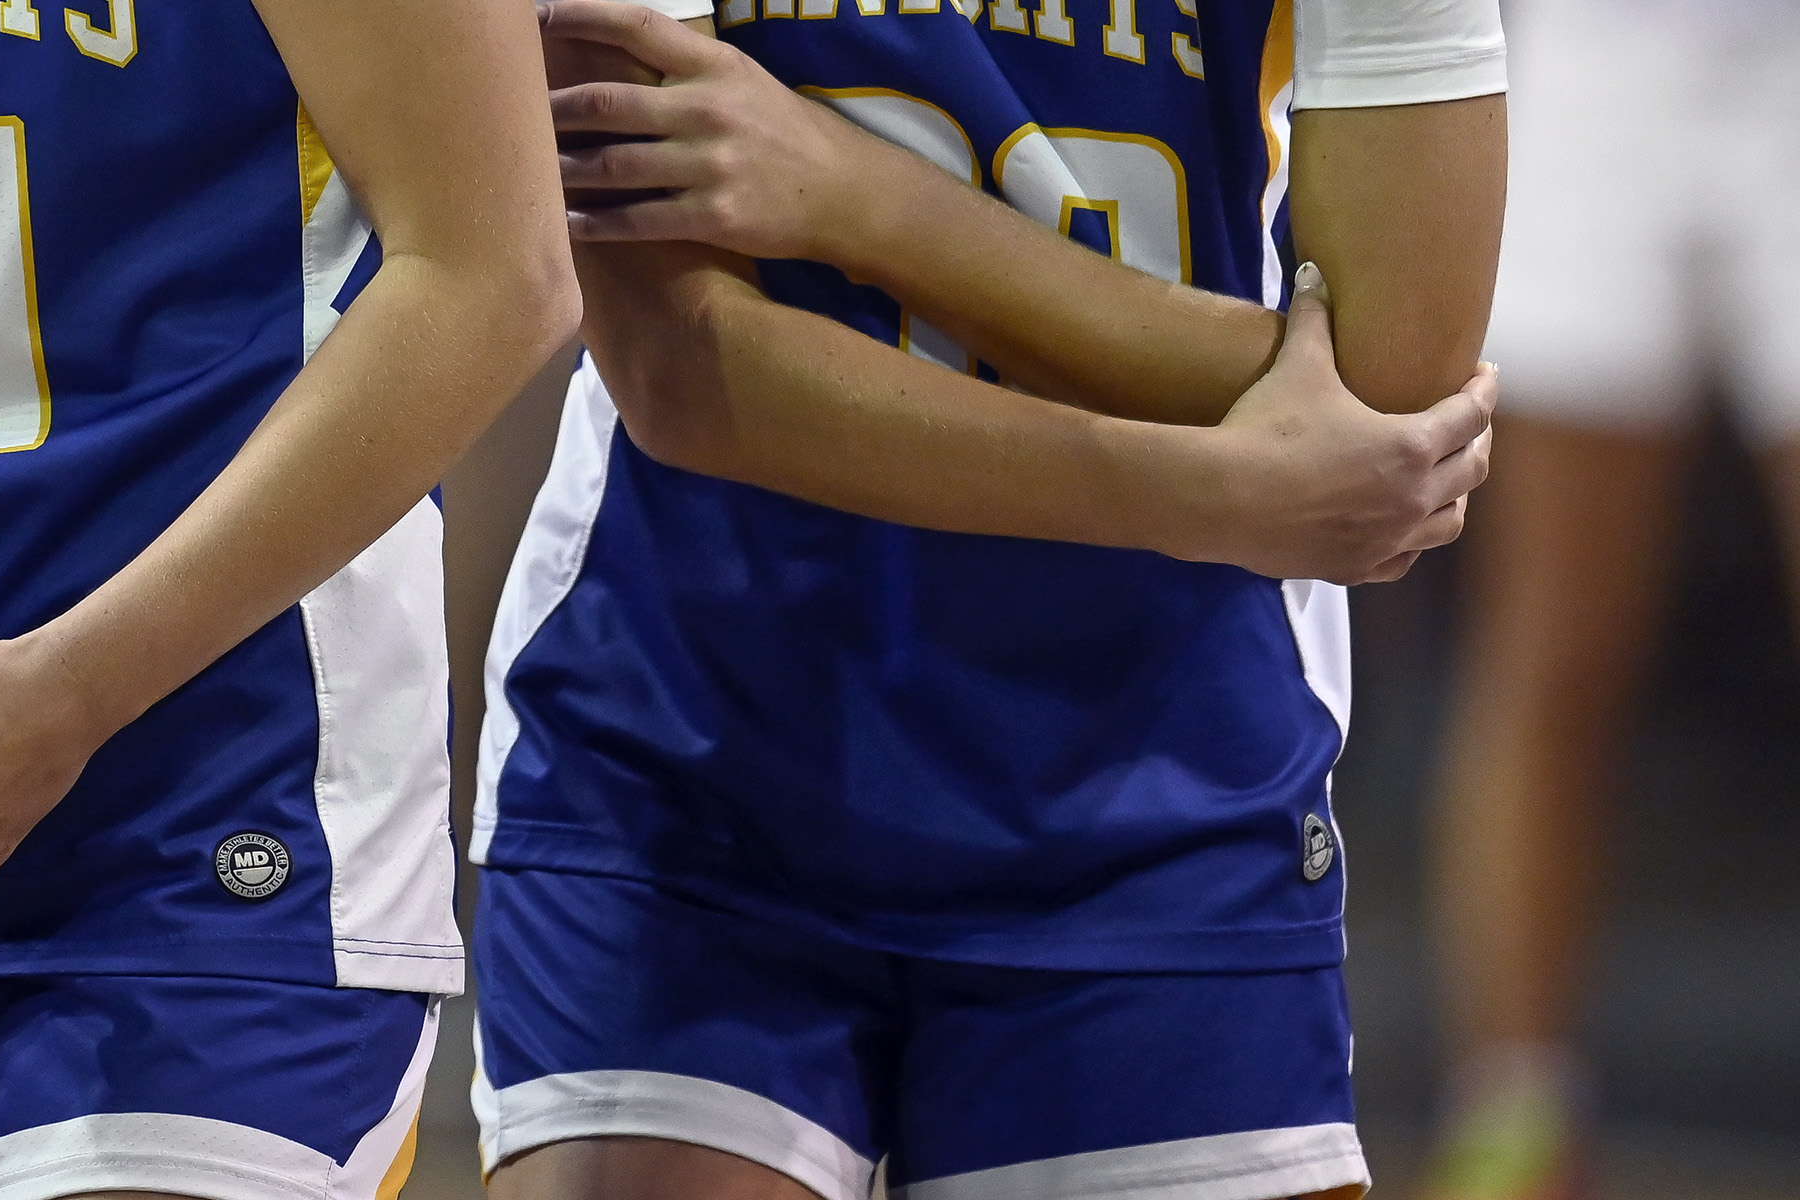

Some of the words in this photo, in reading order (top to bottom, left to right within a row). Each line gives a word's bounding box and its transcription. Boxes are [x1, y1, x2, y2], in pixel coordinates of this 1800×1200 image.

[218, 848, 229, 872] MAKE
[225, 835, 265, 852] ATHLETES
[265, 838, 287, 865] BETTER
[234, 850, 269, 868] MD
[225, 871, 284, 896] AUTHENTIC
